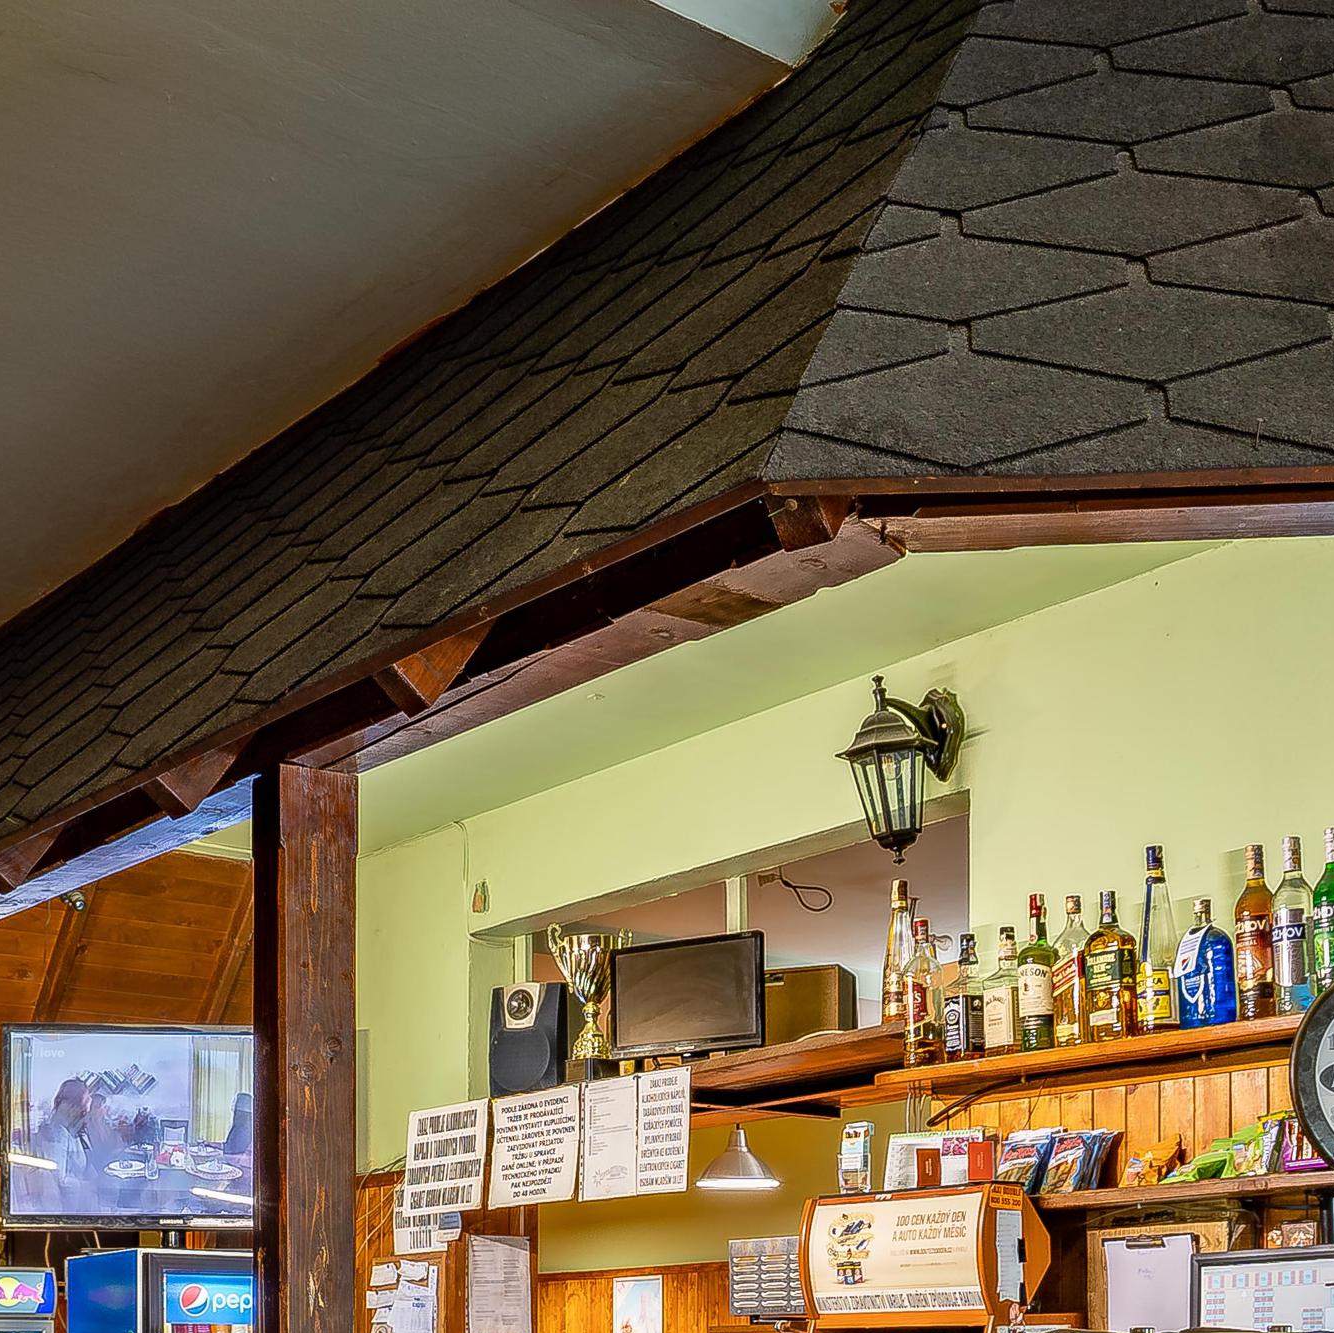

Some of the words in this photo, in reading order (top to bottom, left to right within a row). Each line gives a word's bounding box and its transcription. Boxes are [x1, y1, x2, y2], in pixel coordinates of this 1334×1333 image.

[896, 1214, 910, 1227] 100
[911, 1213, 926, 1226] CEN
[926, 1209, 952, 1225] KAŽDÝ
[952, 1210, 967, 1222] DEN
[898, 1228, 916, 1241] AUTO
[916, 1225, 942, 1240] KAŽDÝ
[943, 1223, 967, 1238] MĚSÍC
